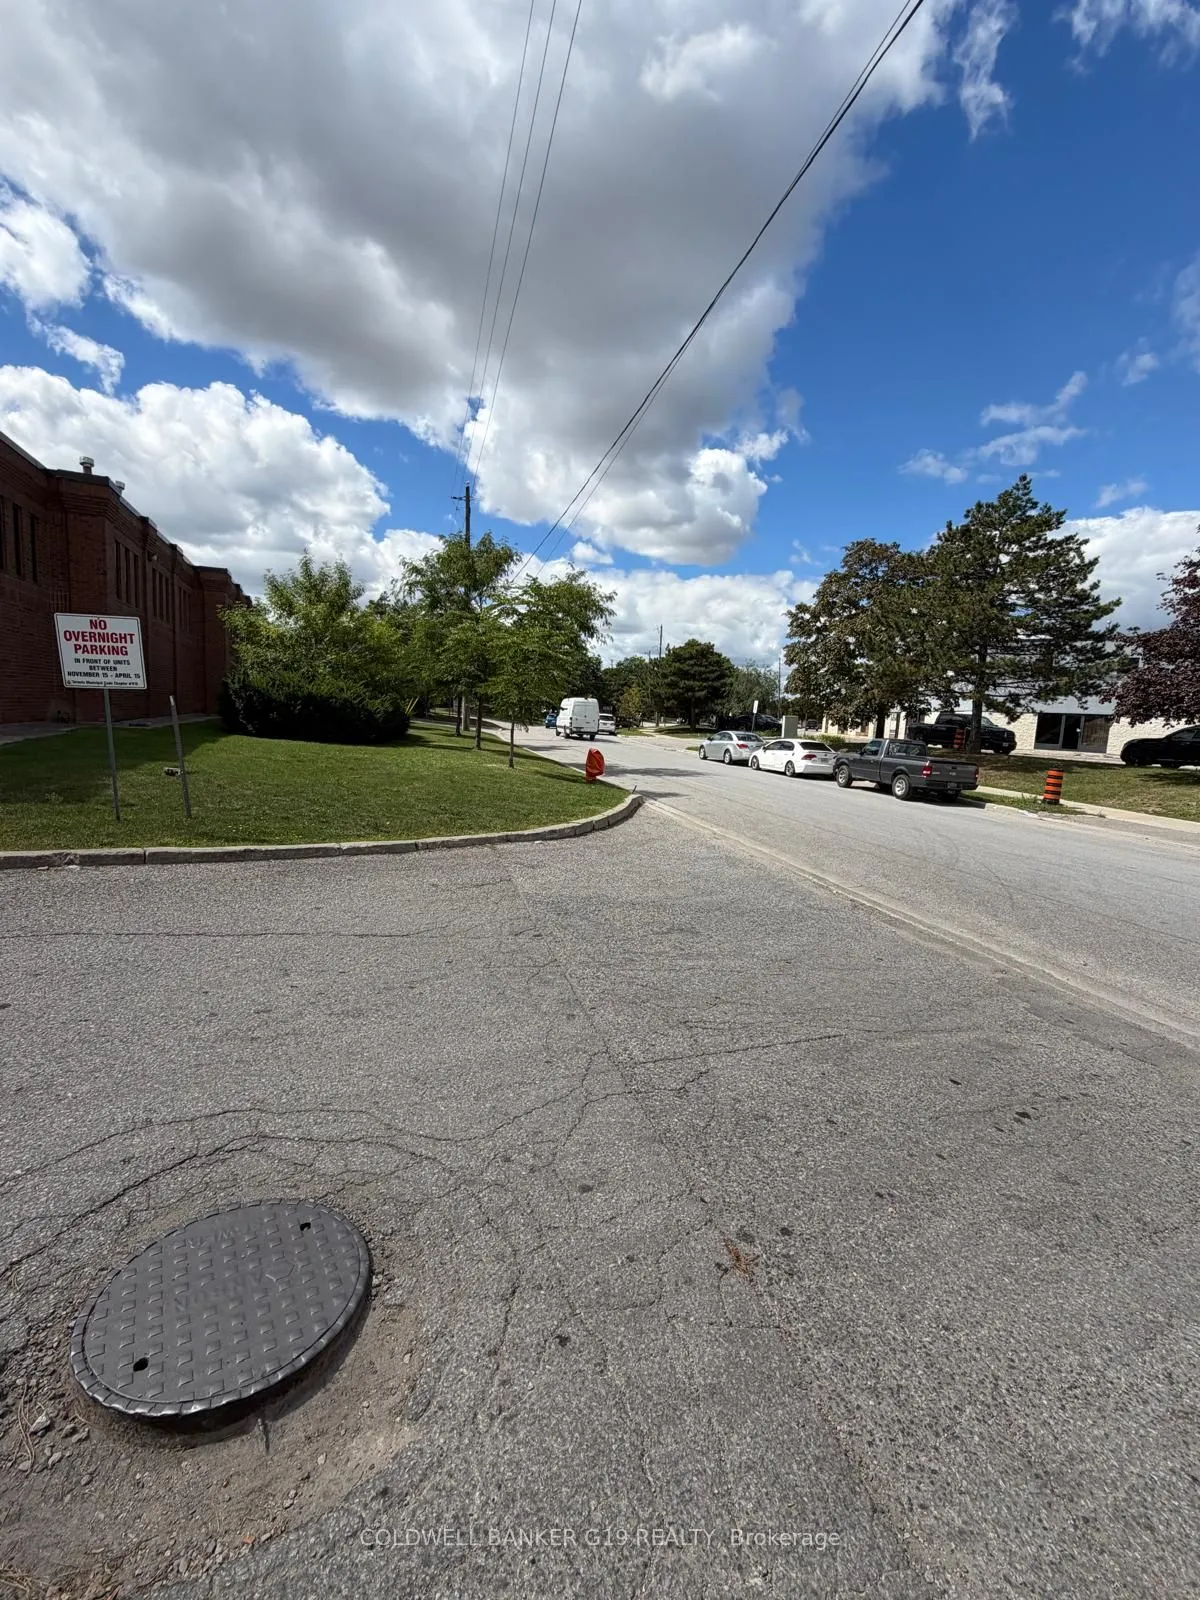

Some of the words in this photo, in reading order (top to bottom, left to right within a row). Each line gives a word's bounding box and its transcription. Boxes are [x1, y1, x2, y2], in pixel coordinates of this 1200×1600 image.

[89, 619, 107, 630] NO
[63, 630, 135, 644] OVERNIGHT
[73, 643, 128, 656] PARKING
